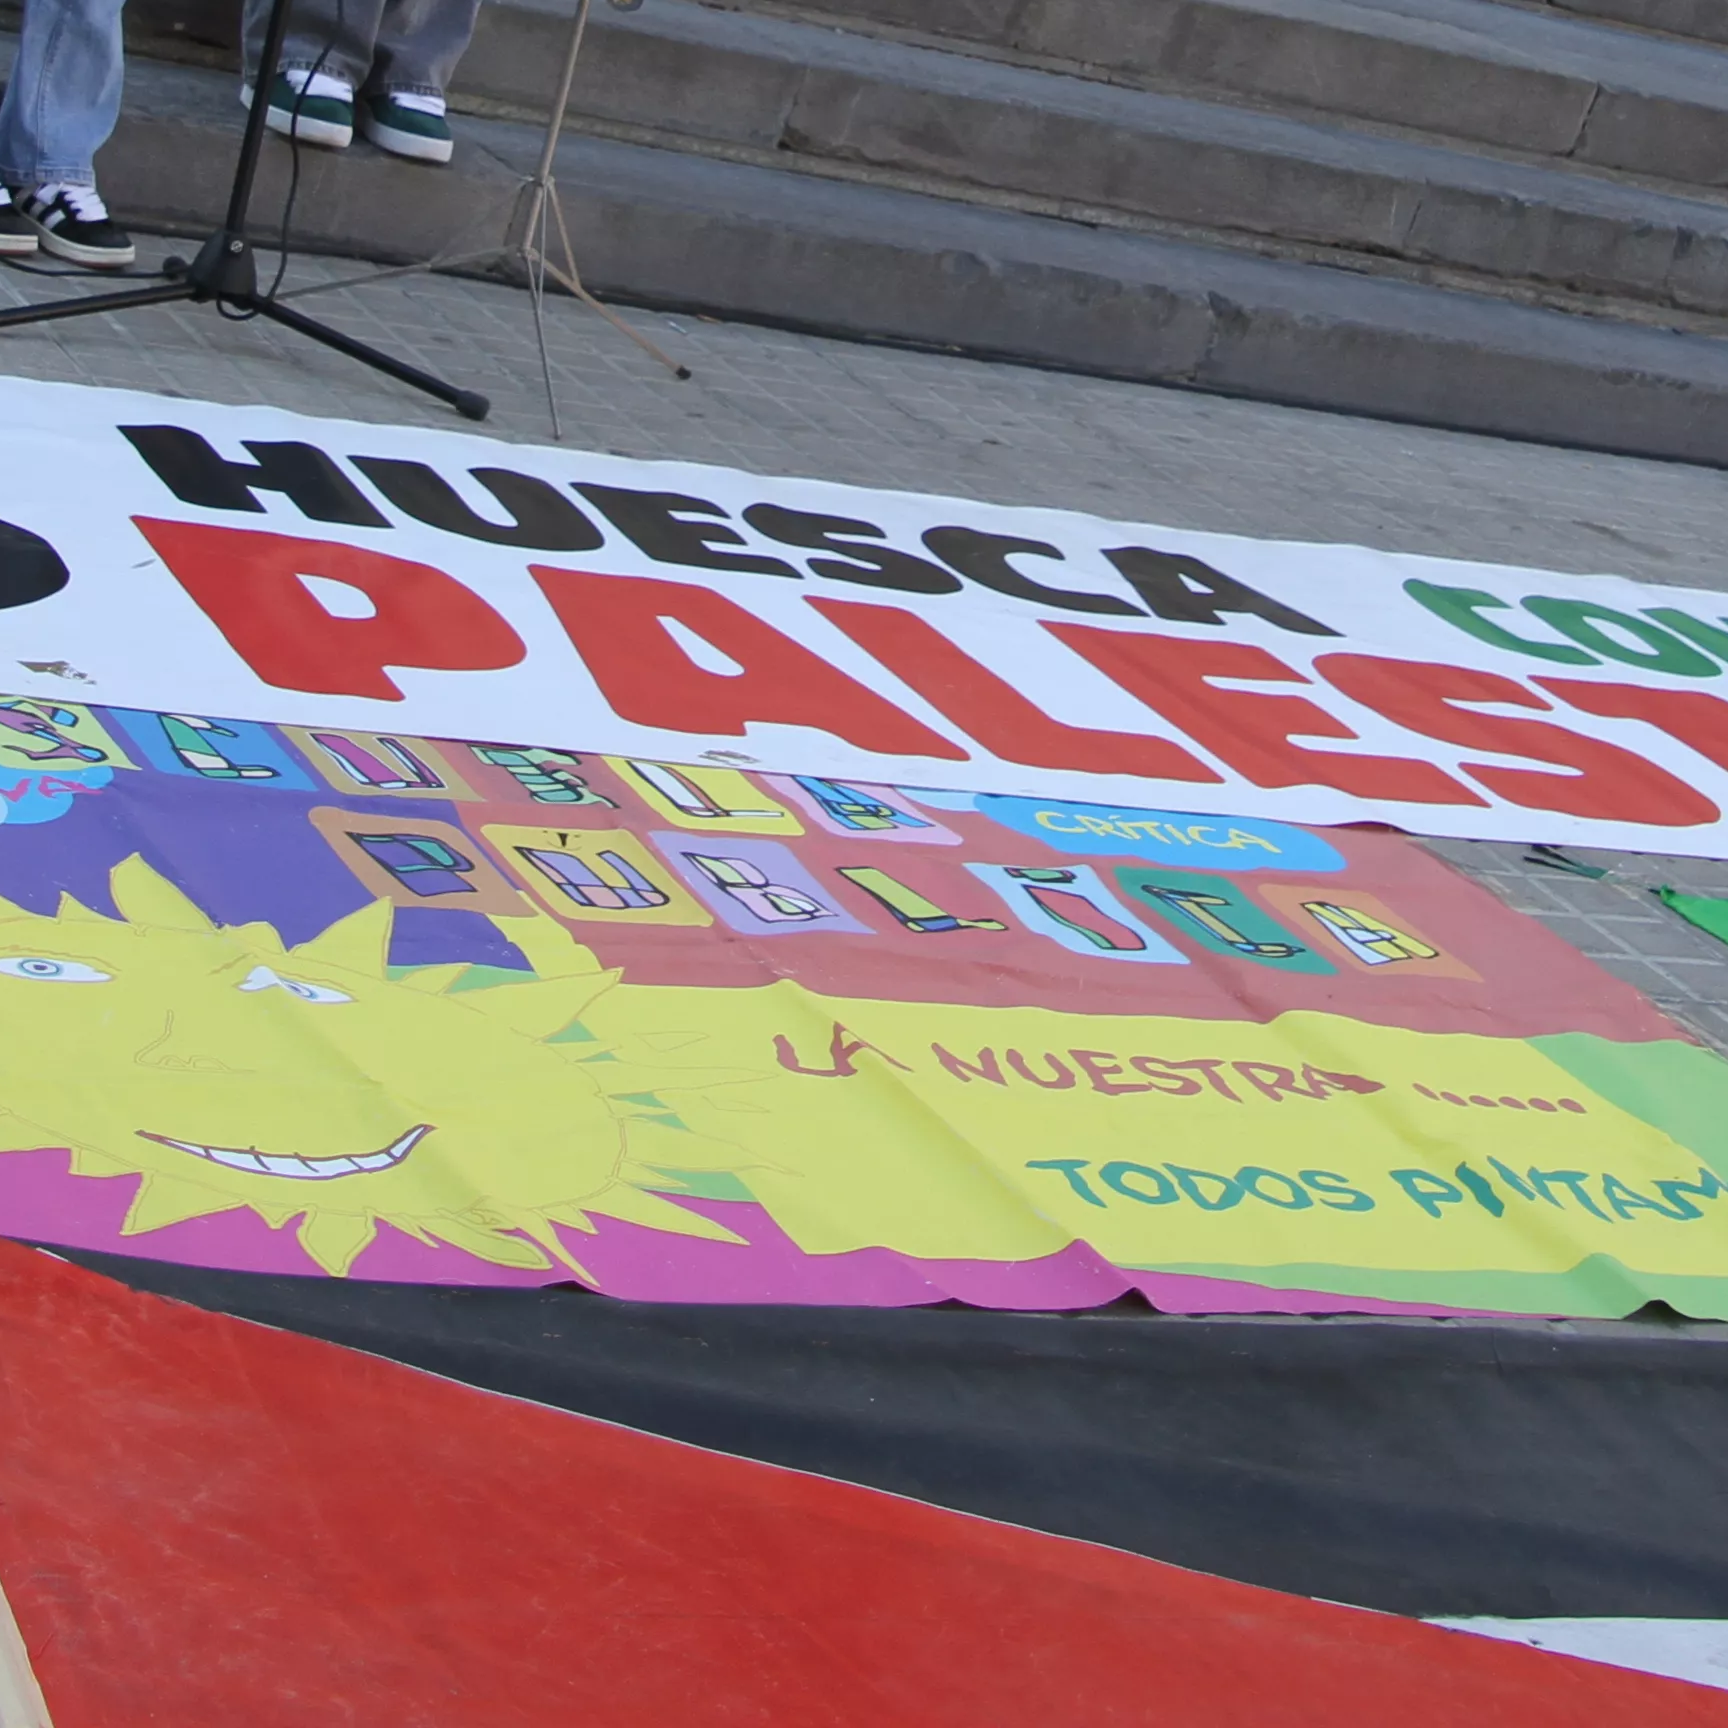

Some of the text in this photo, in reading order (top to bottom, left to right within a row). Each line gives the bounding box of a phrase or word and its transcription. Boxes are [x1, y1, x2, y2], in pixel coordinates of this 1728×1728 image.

[117, 423, 1345, 638] HUESCA
[1035, 807, 1282, 858] CRÍTICA
[345, 829, 1440, 966] PÚBLICA
[771, 1022, 914, 1077] LA
[931, 1043, 1384, 1102] NUESTRA
[1024, 1158, 1379, 1213] TODOS
